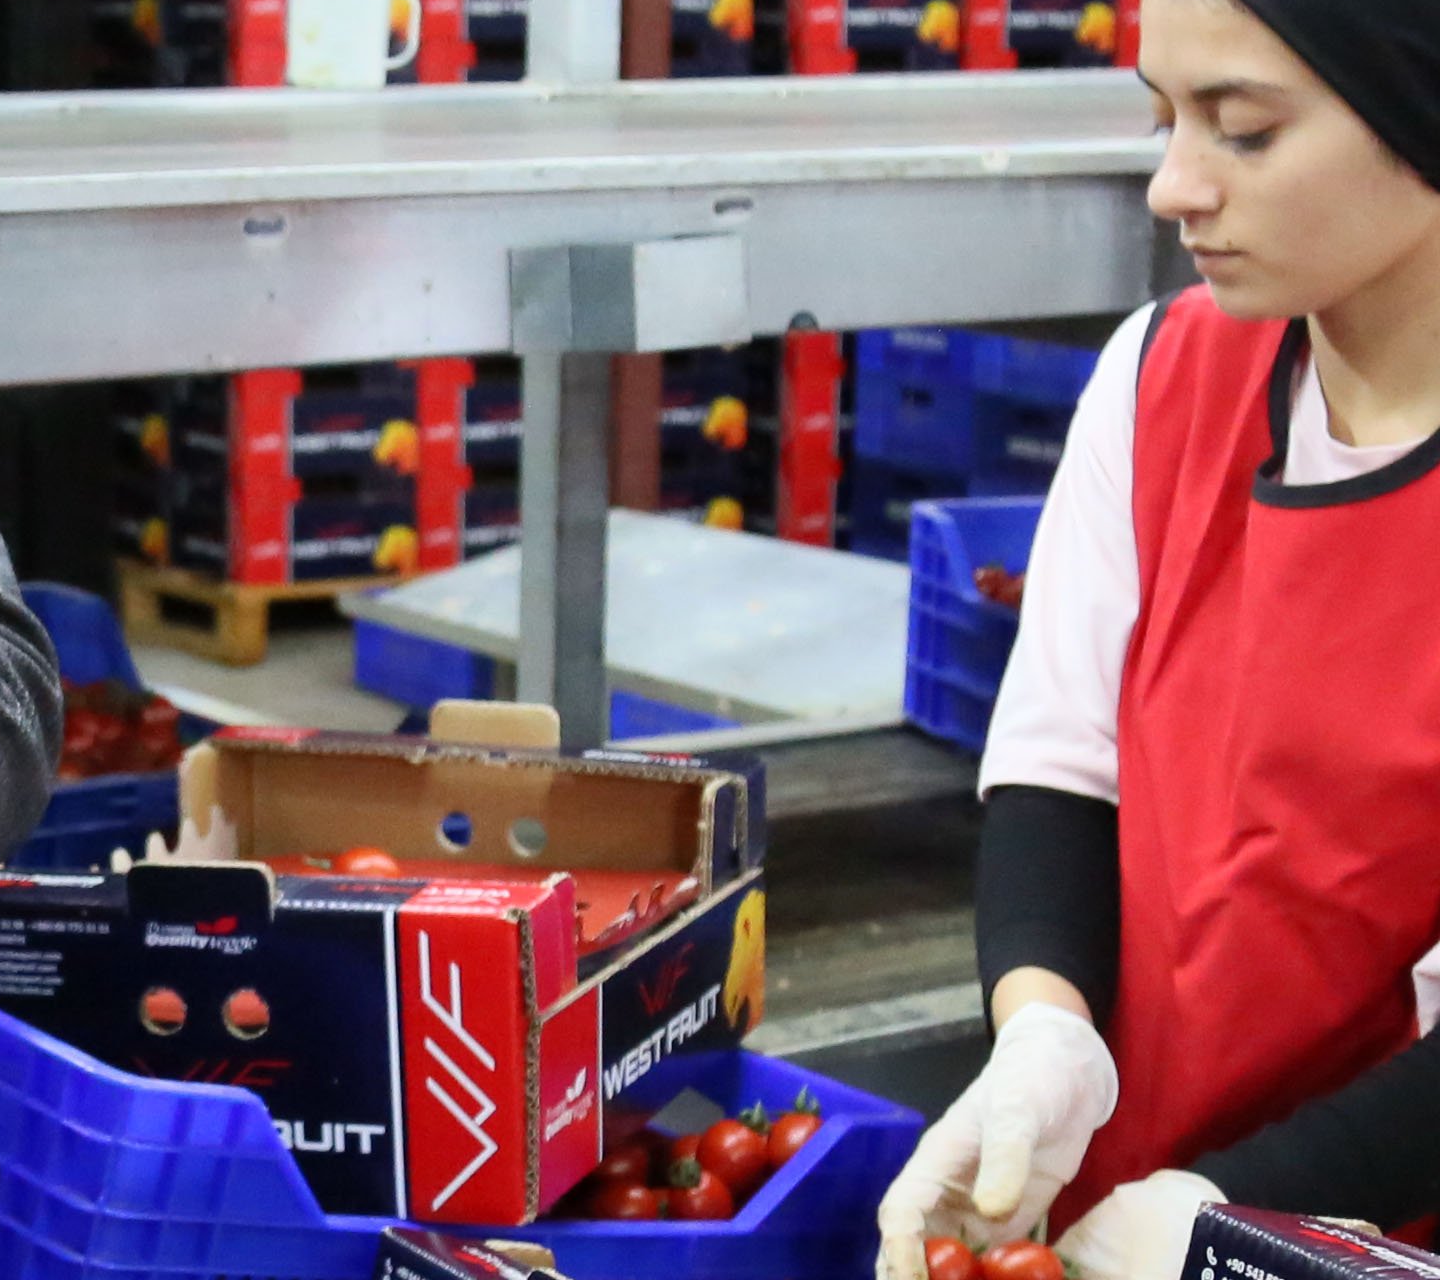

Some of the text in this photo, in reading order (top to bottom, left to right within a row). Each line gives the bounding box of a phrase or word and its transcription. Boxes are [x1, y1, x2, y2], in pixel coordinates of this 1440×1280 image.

[418, 928, 499, 1213] WF
[603, 983, 722, 1101] WEST FRUIT
[1225, 1257, 1245, 1275] +90
[1245, 1262, 1265, 1280] 543
